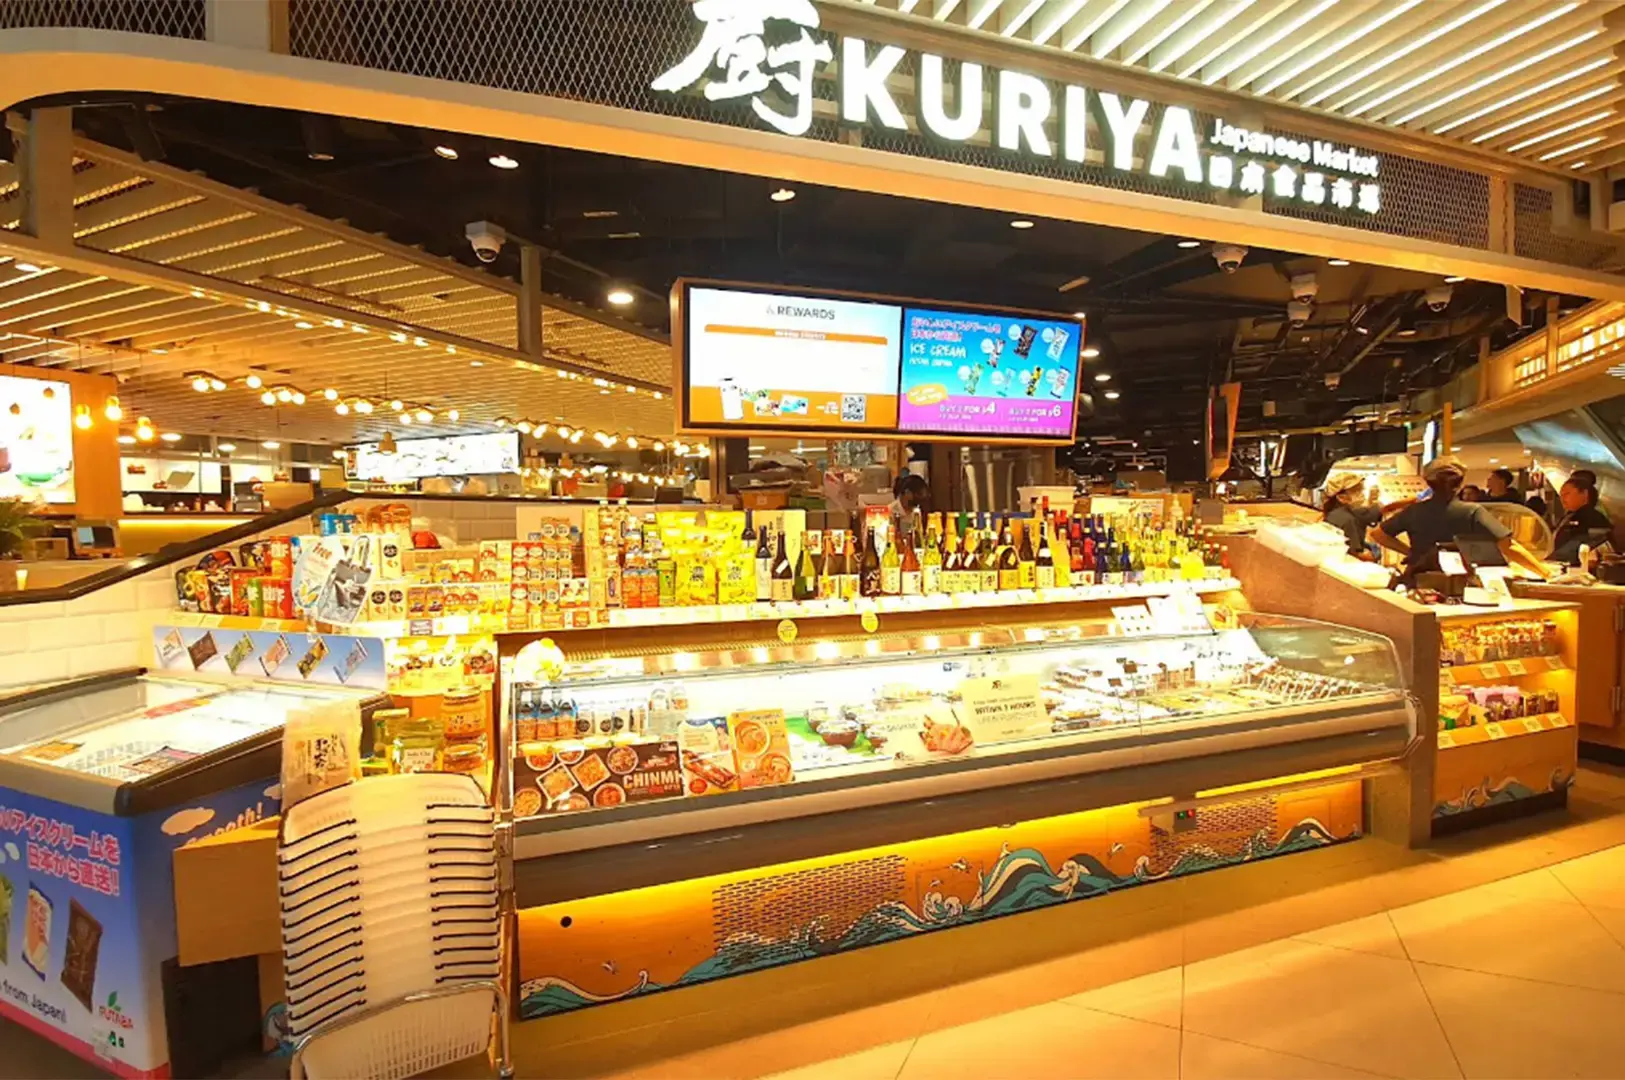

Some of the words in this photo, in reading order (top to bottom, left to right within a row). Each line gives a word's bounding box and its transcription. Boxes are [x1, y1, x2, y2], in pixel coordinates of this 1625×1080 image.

[843, 37, 1203, 183] KURIYA
[1210, 118, 1311, 162] Japanese
[1313, 141, 1378, 177] Market
[777, 306, 835, 320] REWARDS
[910, 342, 926, 355] ICE
[930, 344, 967, 358] CREAM
[964, 404, 980, 413] FOR
[1032, 408, 1047, 416] FOR
[3, 979, 31, 1004] from
[31, 993, 68, 1024] Japan!
